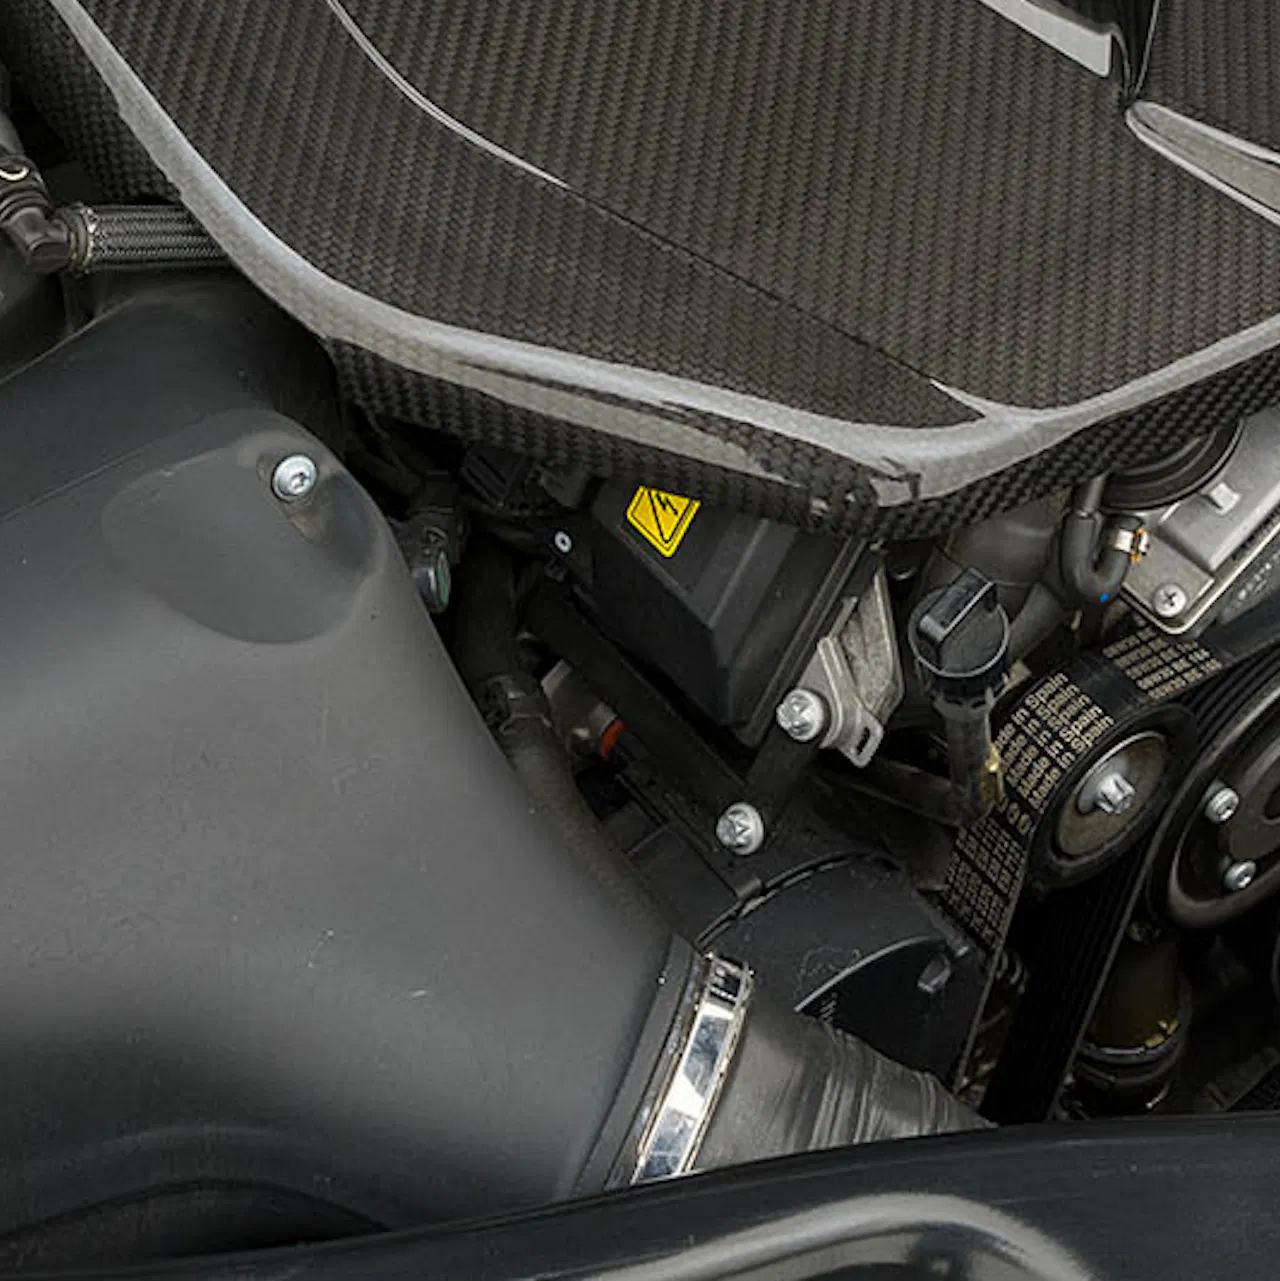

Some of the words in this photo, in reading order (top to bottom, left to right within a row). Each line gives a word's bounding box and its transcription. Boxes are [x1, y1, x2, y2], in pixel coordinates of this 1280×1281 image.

[1011, 707, 1030, 725] in
[1024, 672, 1069, 710] Spain
[1036, 684, 1080, 720] Spain
[1047, 694, 1092, 732] Spain
[1059, 705, 1104, 743] Spain
[1070, 715, 1115, 754] Spain
